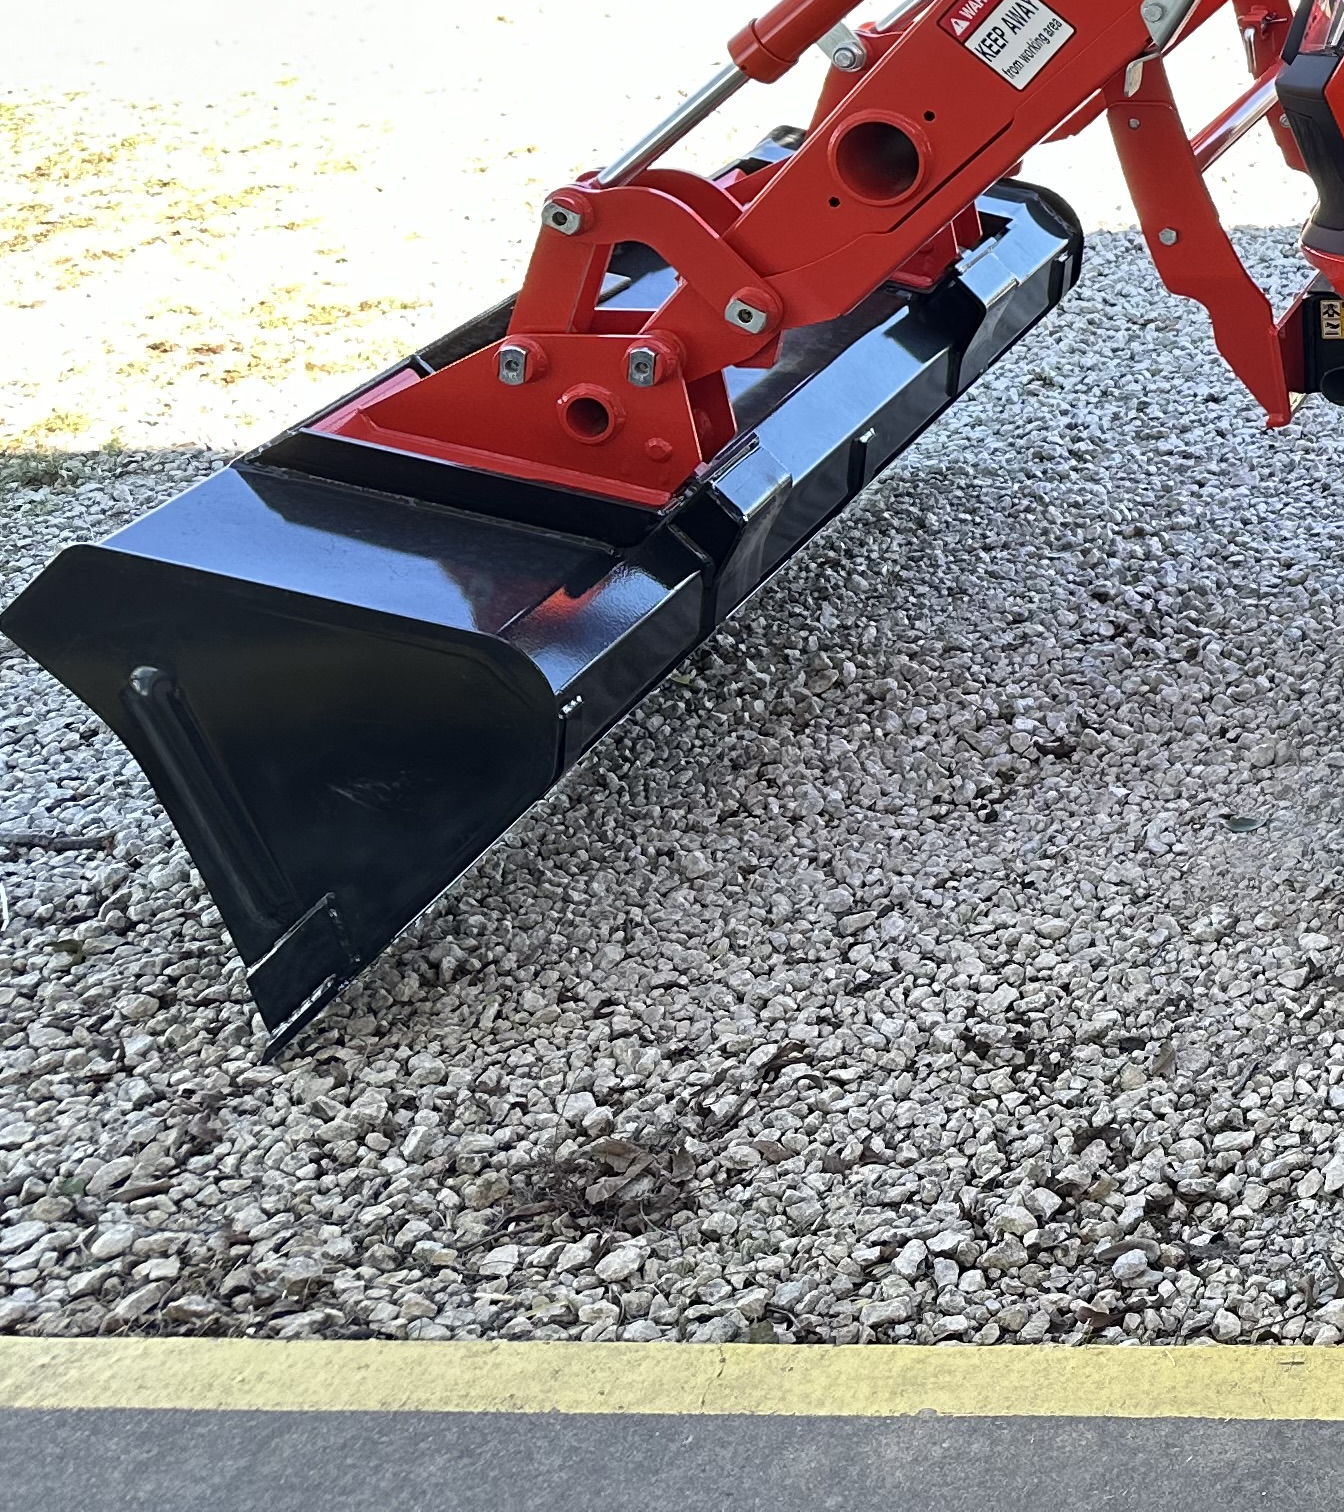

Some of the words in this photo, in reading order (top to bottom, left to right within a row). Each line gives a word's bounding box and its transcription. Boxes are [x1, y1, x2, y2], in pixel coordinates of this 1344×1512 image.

[974, 26, 1009, 62] KEEP
[1002, 59, 1025, 79] from
[1019, 33, 1051, 64] working
[1043, 18, 1063, 37] area
